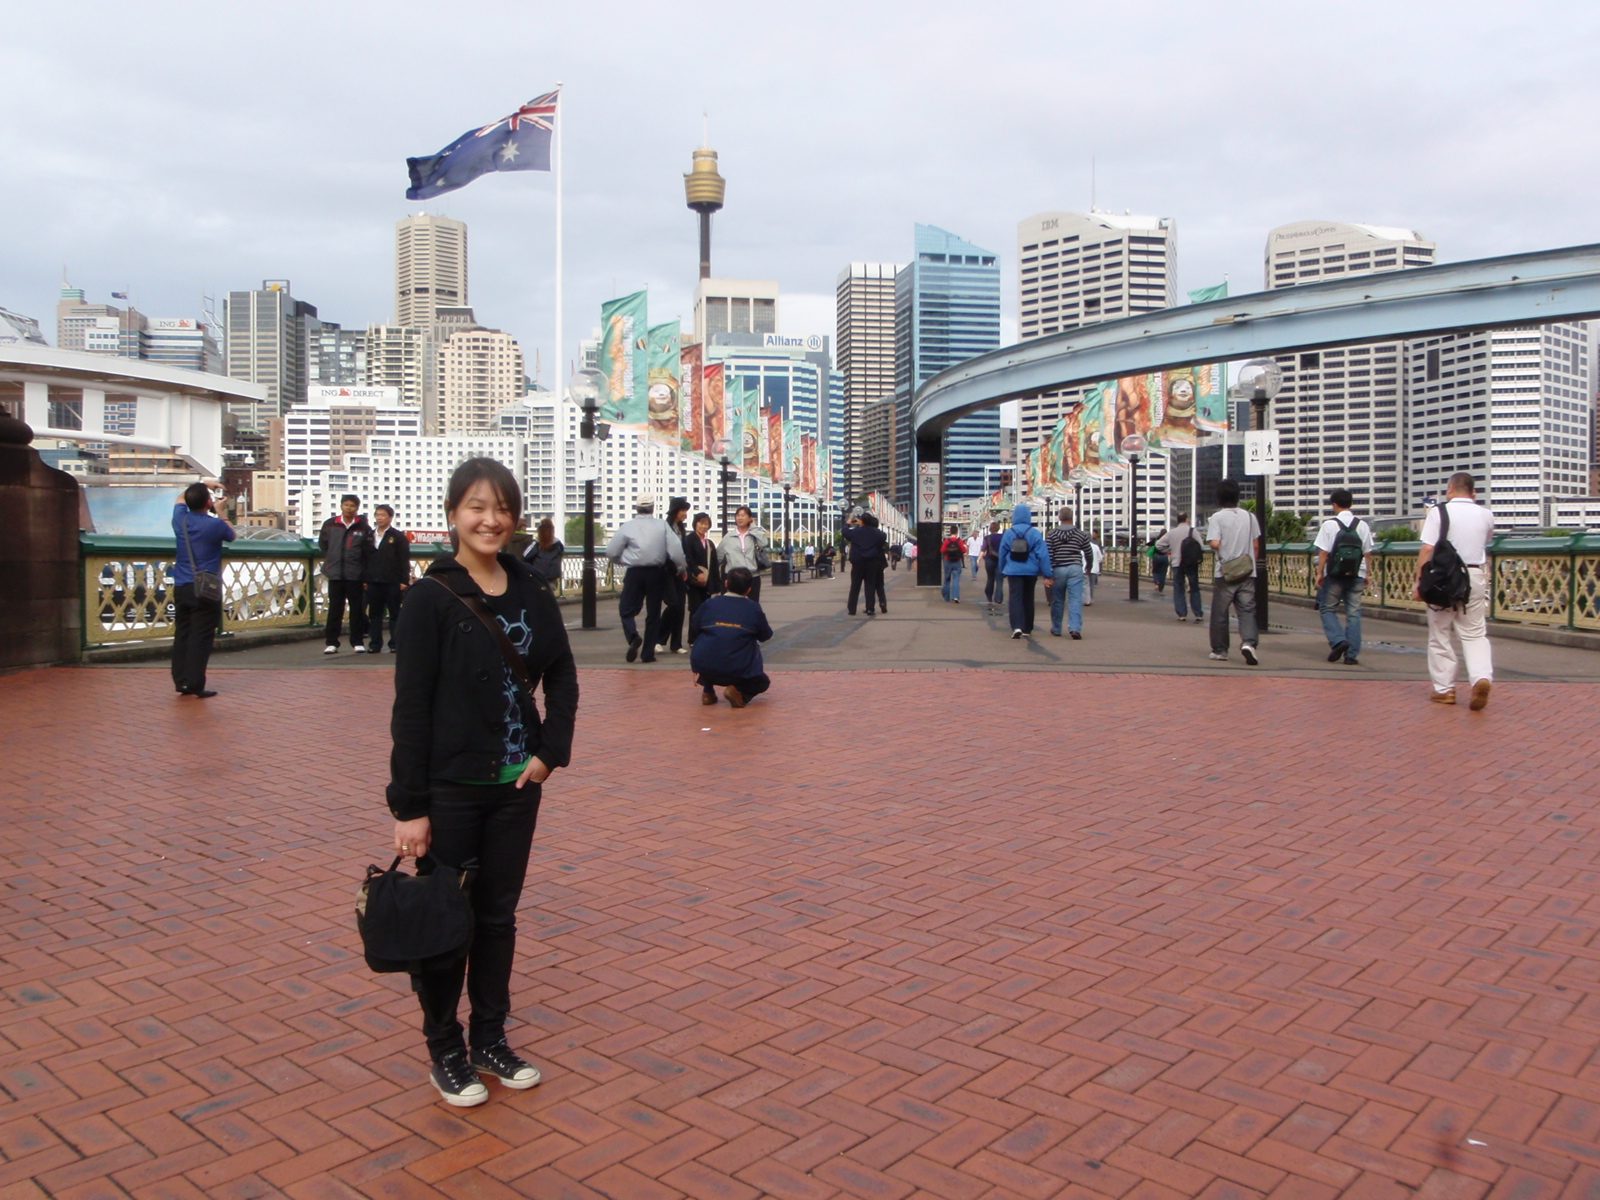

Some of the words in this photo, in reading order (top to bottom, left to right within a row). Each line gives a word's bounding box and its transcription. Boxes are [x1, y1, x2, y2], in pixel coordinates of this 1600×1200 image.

[1041, 218, 1059, 231] IBM
[160, 320, 176, 328] ING
[766, 335, 804, 347] Allianz
[321, 389, 338, 397] ING
